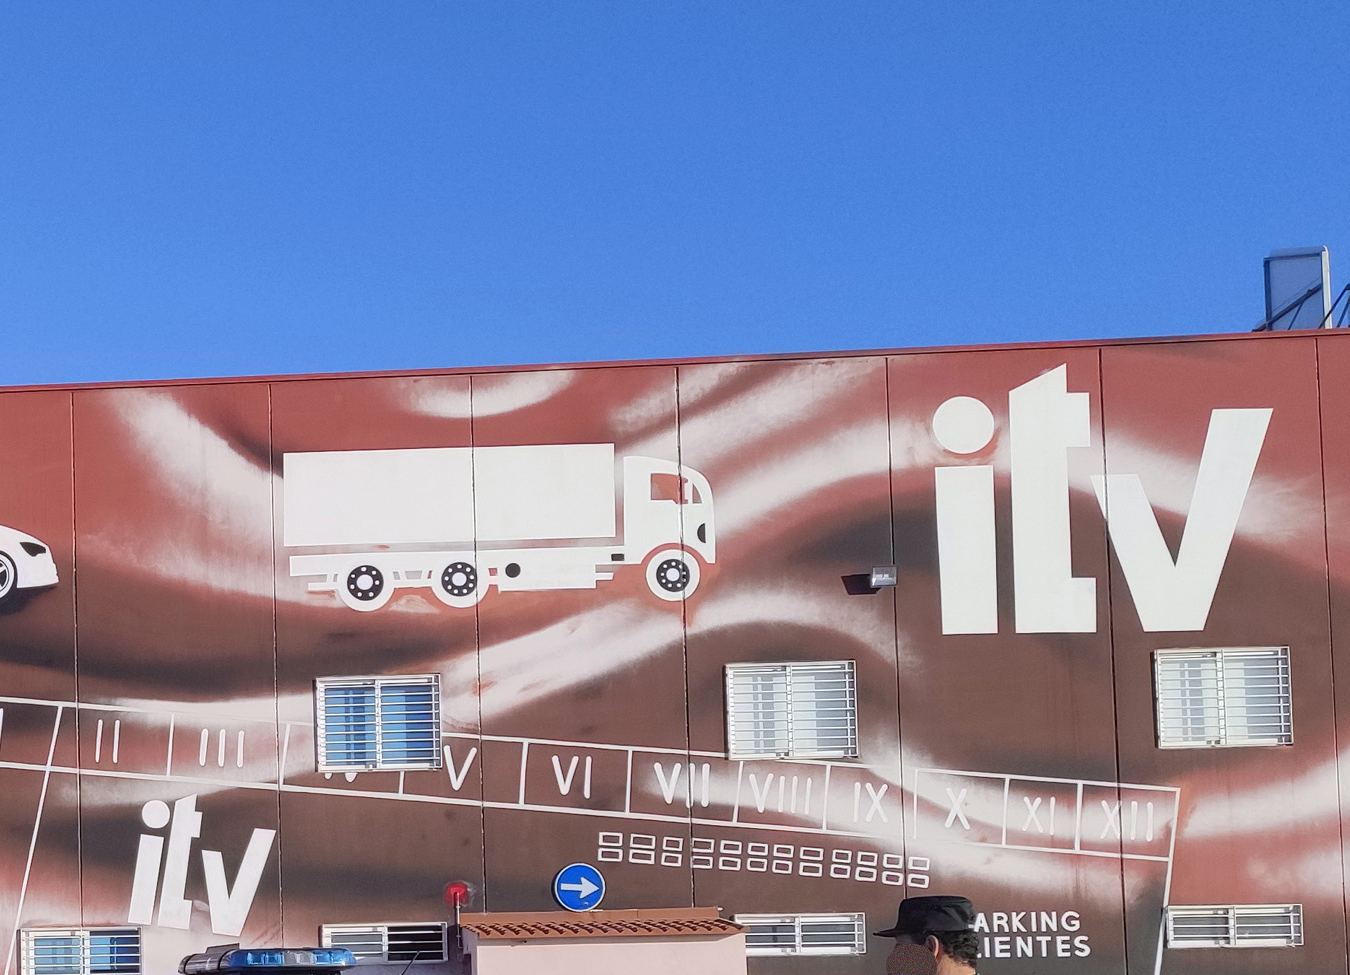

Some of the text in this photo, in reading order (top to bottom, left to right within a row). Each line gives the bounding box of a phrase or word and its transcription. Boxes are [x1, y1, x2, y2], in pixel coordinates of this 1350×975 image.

[933, 363, 1274, 635] itv
[443, 744, 478, 791] V
[551, 755, 592, 799] VI
[653, 762, 711, 808] VII
[749, 773, 812, 815] VIII
[852, 781, 889, 823] IX
[944, 787, 971, 830] X
[1021, 796, 1056, 836] XI
[1100, 800, 1154, 842] XII
[128, 793, 277, 937] itv
[968, 911, 1081, 933] ARKING
[977, 935, 1091, 958] IENTES
